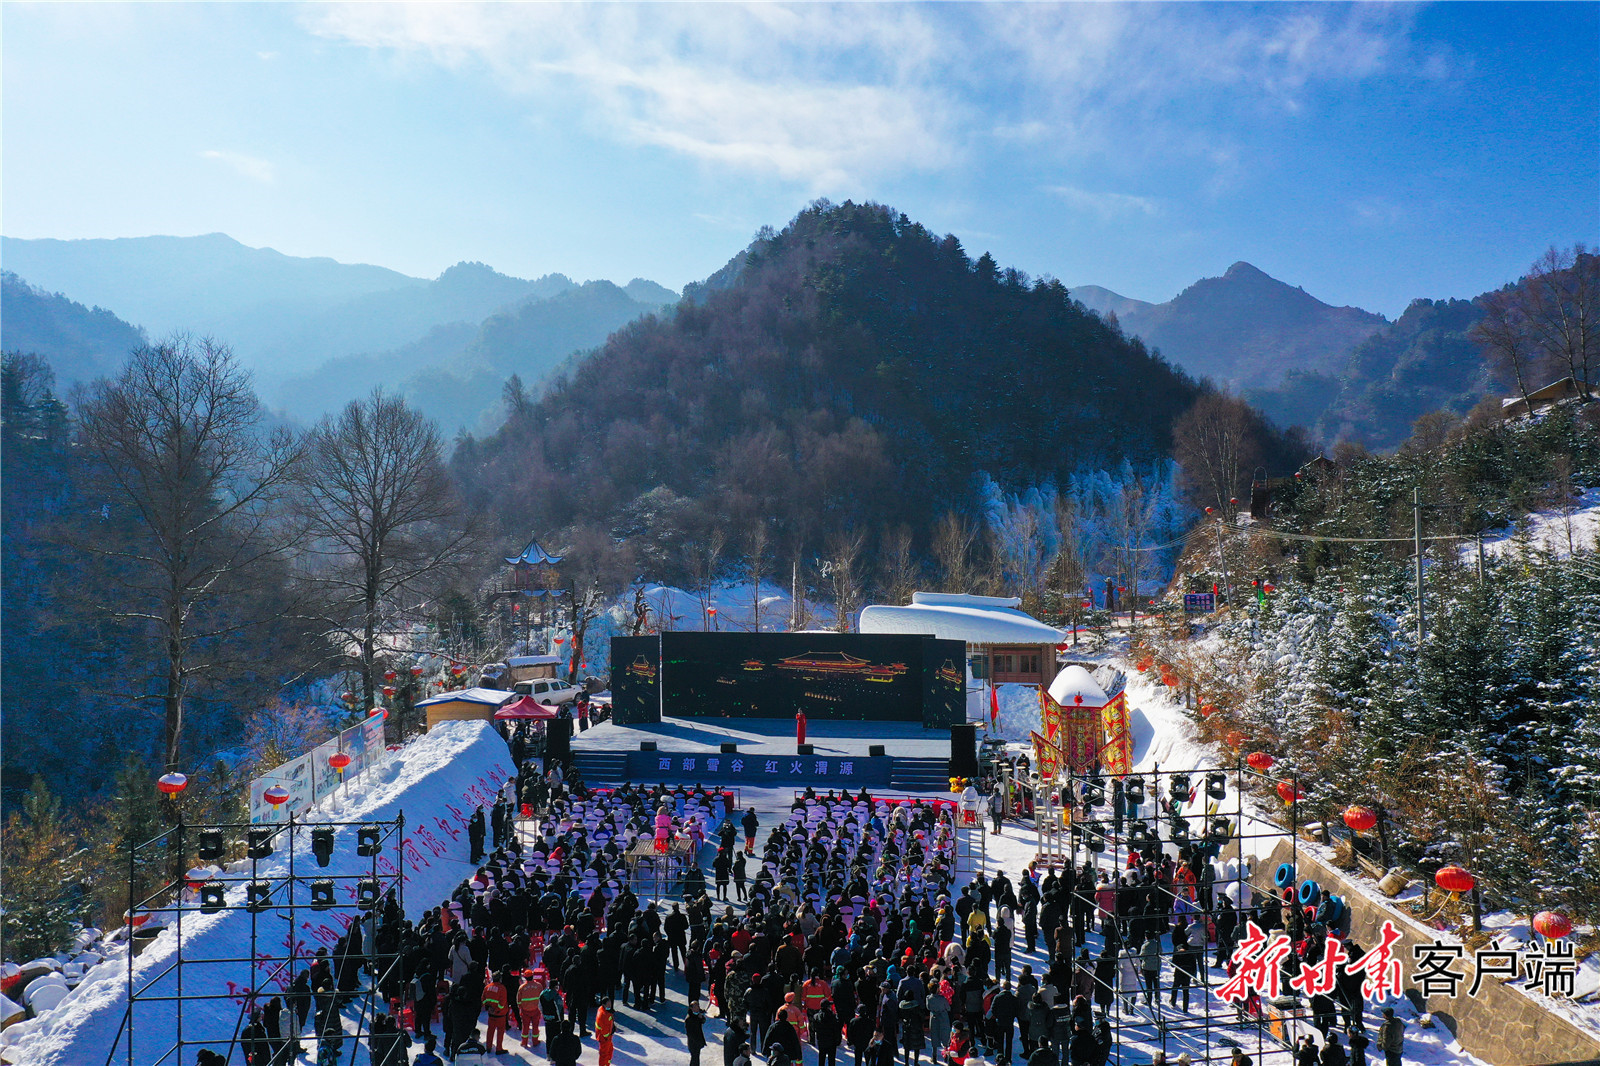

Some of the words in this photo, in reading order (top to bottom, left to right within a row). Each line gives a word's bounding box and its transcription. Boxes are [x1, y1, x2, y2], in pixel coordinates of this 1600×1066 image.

[658, 757, 745, 773] 西部雪谷
[765, 760, 854, 776] 红火渭源
